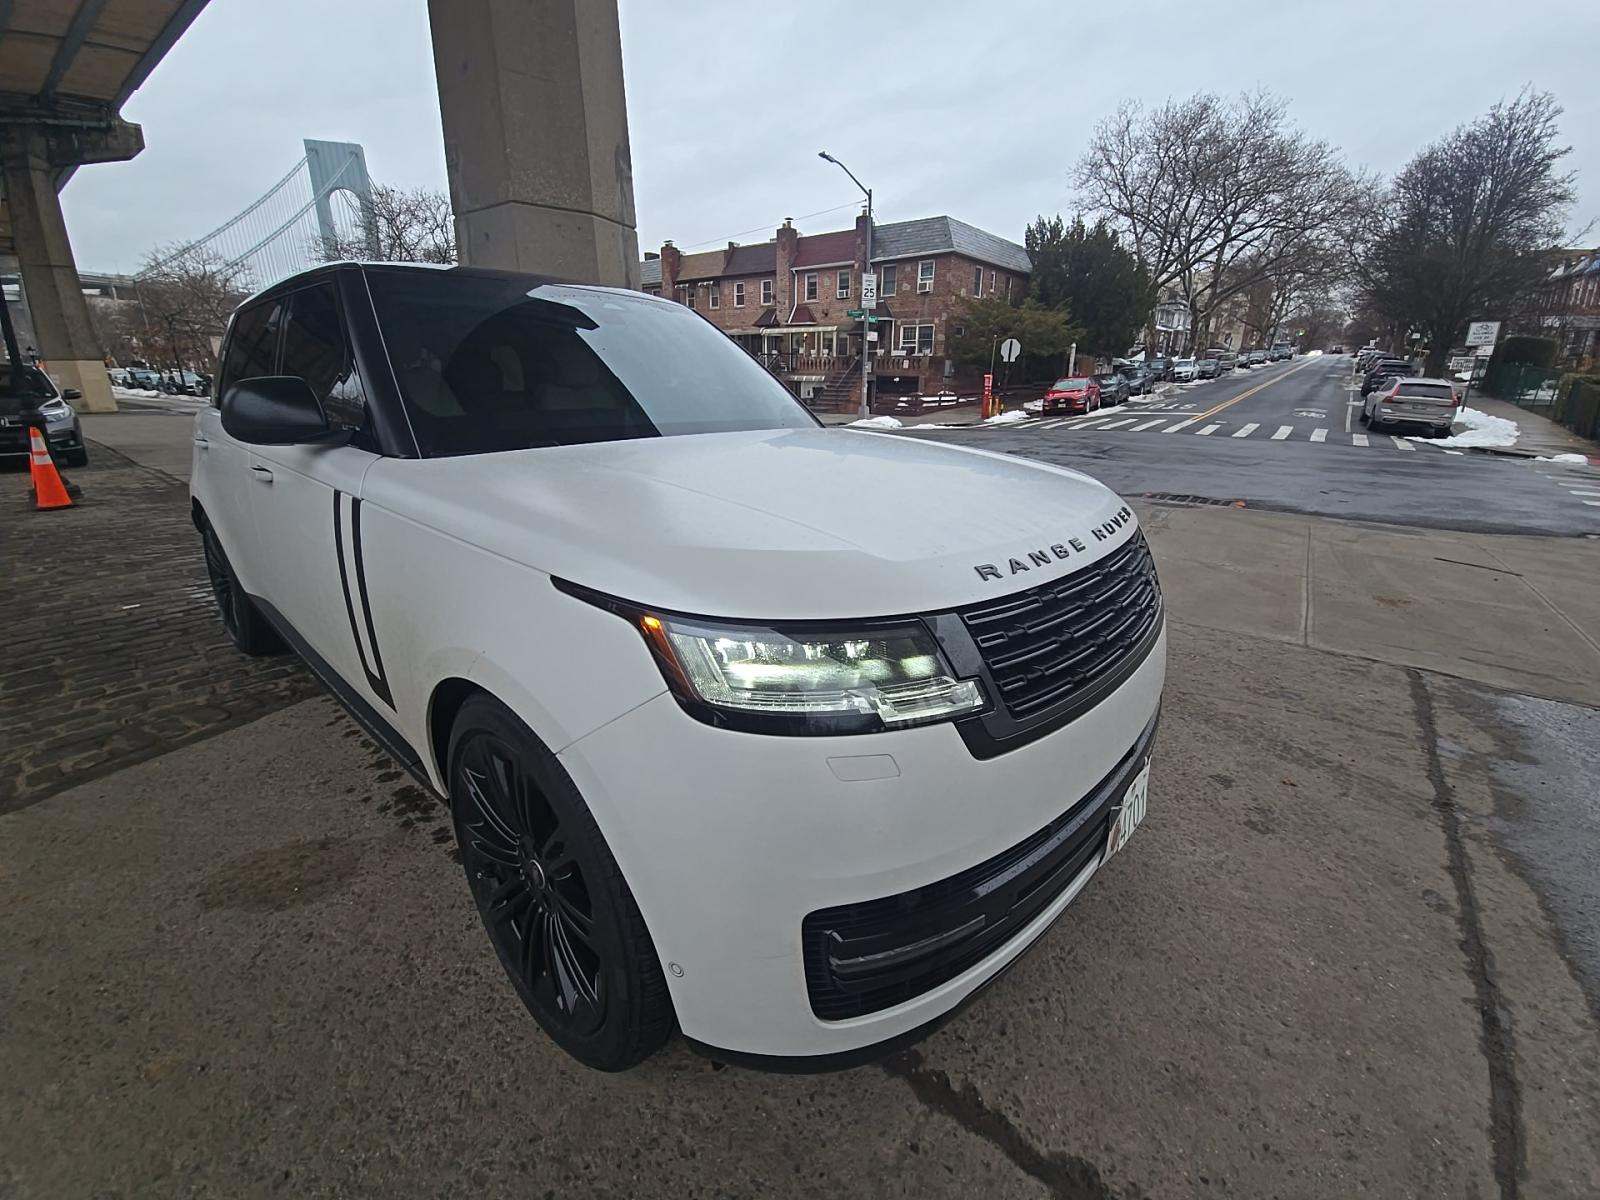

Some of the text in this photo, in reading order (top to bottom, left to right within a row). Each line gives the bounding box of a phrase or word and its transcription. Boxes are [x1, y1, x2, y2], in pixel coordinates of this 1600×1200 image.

[863, 287, 875, 298] 25
[973, 506, 1132, 581] RANGE ROVER
